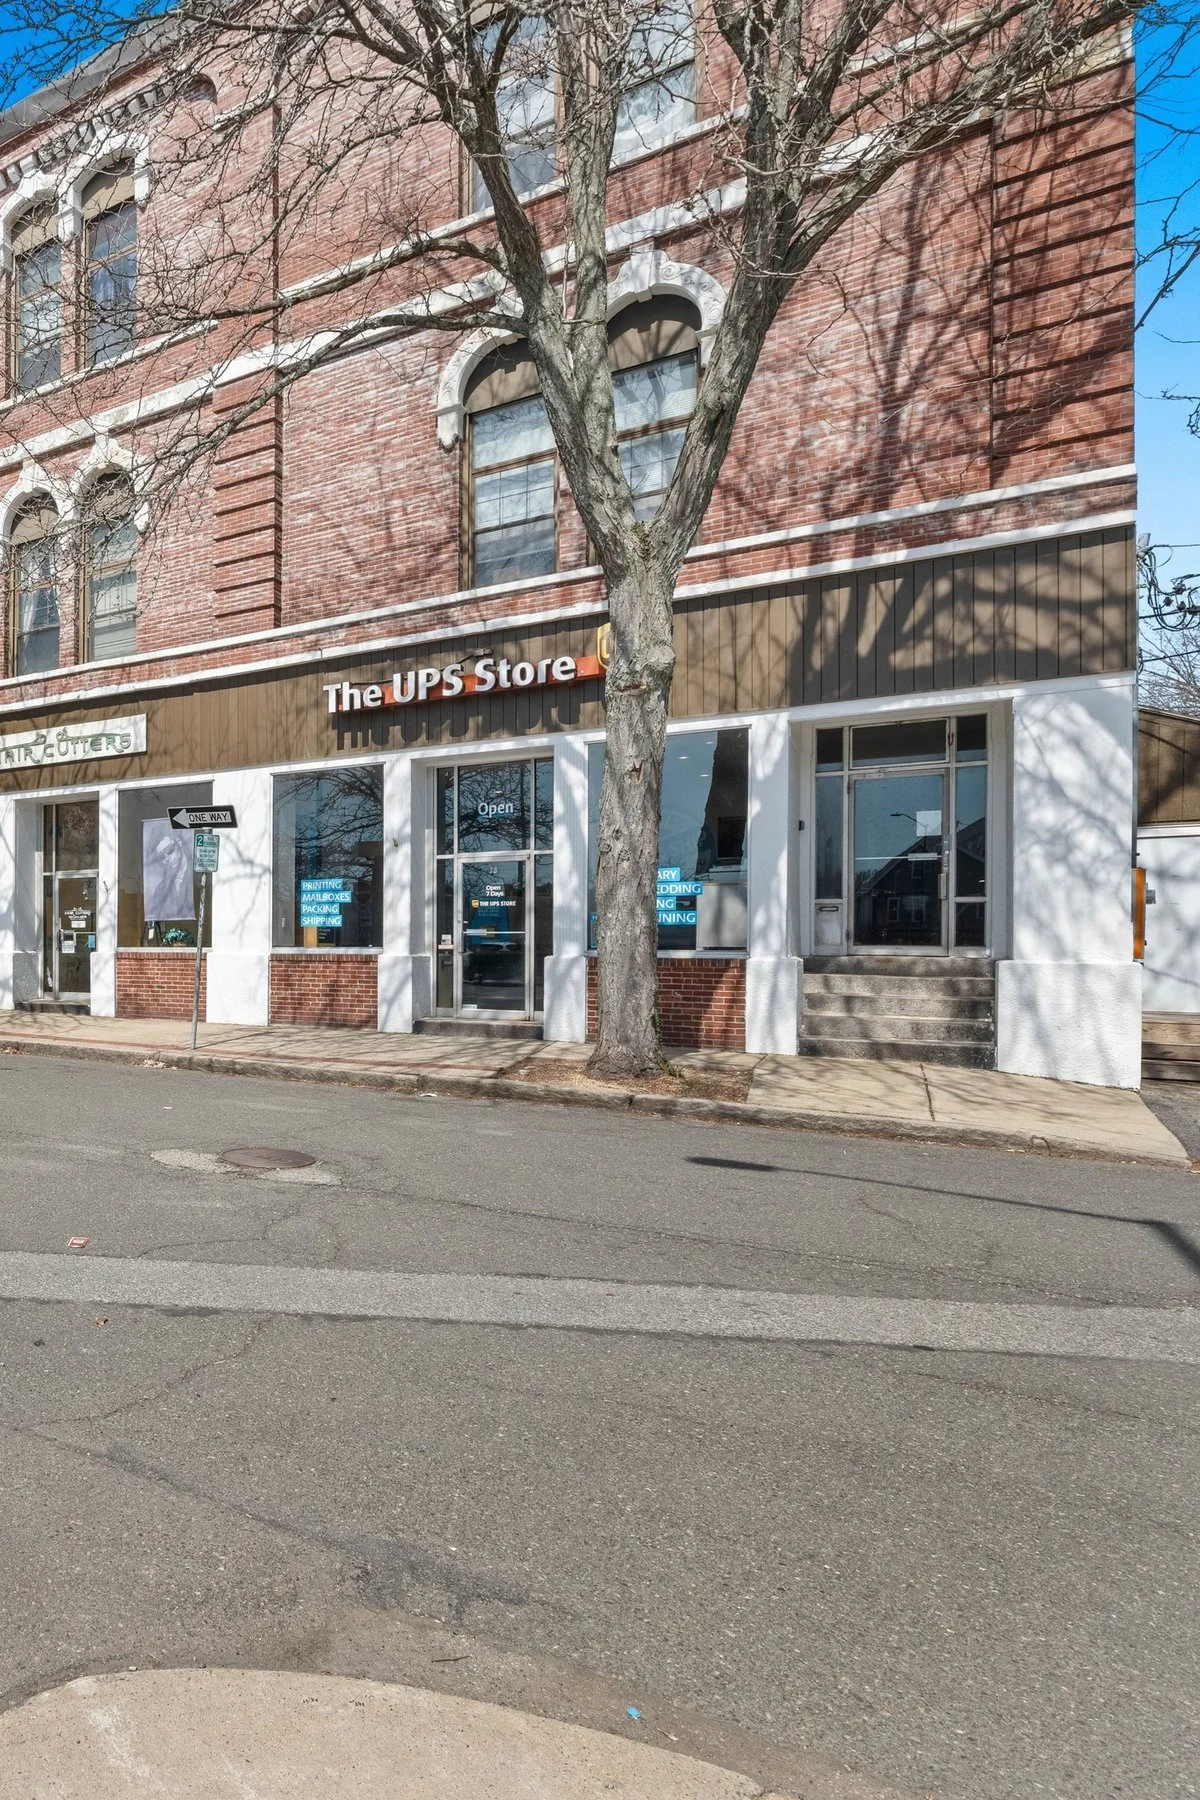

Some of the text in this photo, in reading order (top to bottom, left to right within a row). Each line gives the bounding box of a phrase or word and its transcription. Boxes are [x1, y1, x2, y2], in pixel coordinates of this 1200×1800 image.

[323, 656, 576, 713] The UPS Store
[44, 733, 131, 757] CUTTERS
[478, 802, 514, 818] Open
[188, 812, 228, 823] ONE WAY
[197, 836, 204, 847] 2
[657, 870, 678, 880] ARY
[303, 881, 341, 890] PRINTING
[657, 883, 701, 894] EDDING
[303, 892, 350, 902] MAILBOXES
[303, 904, 338, 913] PACKING
[303, 916, 341, 925] SHIPPING
[658, 913, 696, 923] NING
